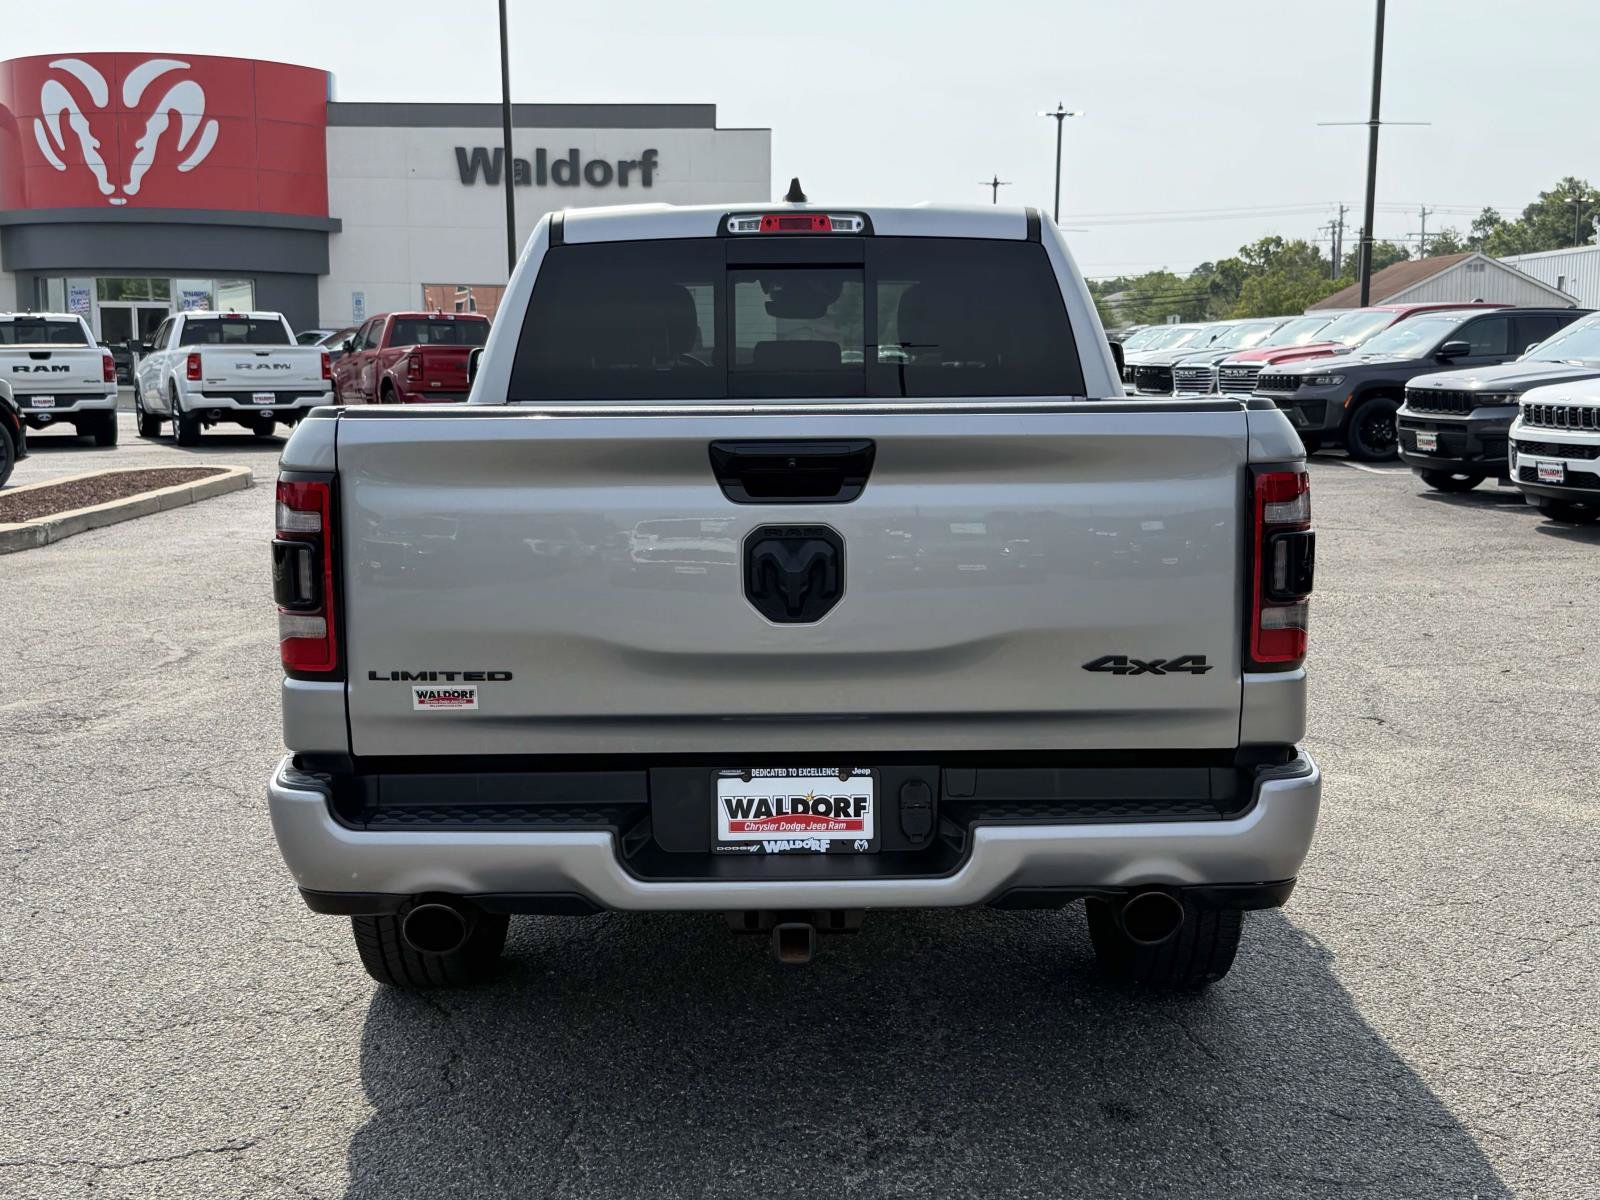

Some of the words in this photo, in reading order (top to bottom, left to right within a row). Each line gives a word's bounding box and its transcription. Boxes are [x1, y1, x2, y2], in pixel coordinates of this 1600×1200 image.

[455, 146, 658, 187] Waldorf
[12, 365, 70, 373] RAM
[1081, 655, 1214, 675] 4x4
[368, 670, 513, 681] LIMITED
[416, 690, 475, 699] WALDORF
[751, 768, 787, 777] DEDICATED
[788, 768, 797, 776] TO
[798, 767, 840, 776] EXCELLENCE
[851, 767, 871, 775] Jeep
[721, 796, 870, 819] WALDORF
[744, 822, 778, 832] Chrysler
[779, 821, 806, 831] Dodge
[807, 822, 827, 831] Jeep
[828, 821, 847, 830] Ram
[763, 840, 830, 853] WALDORF
